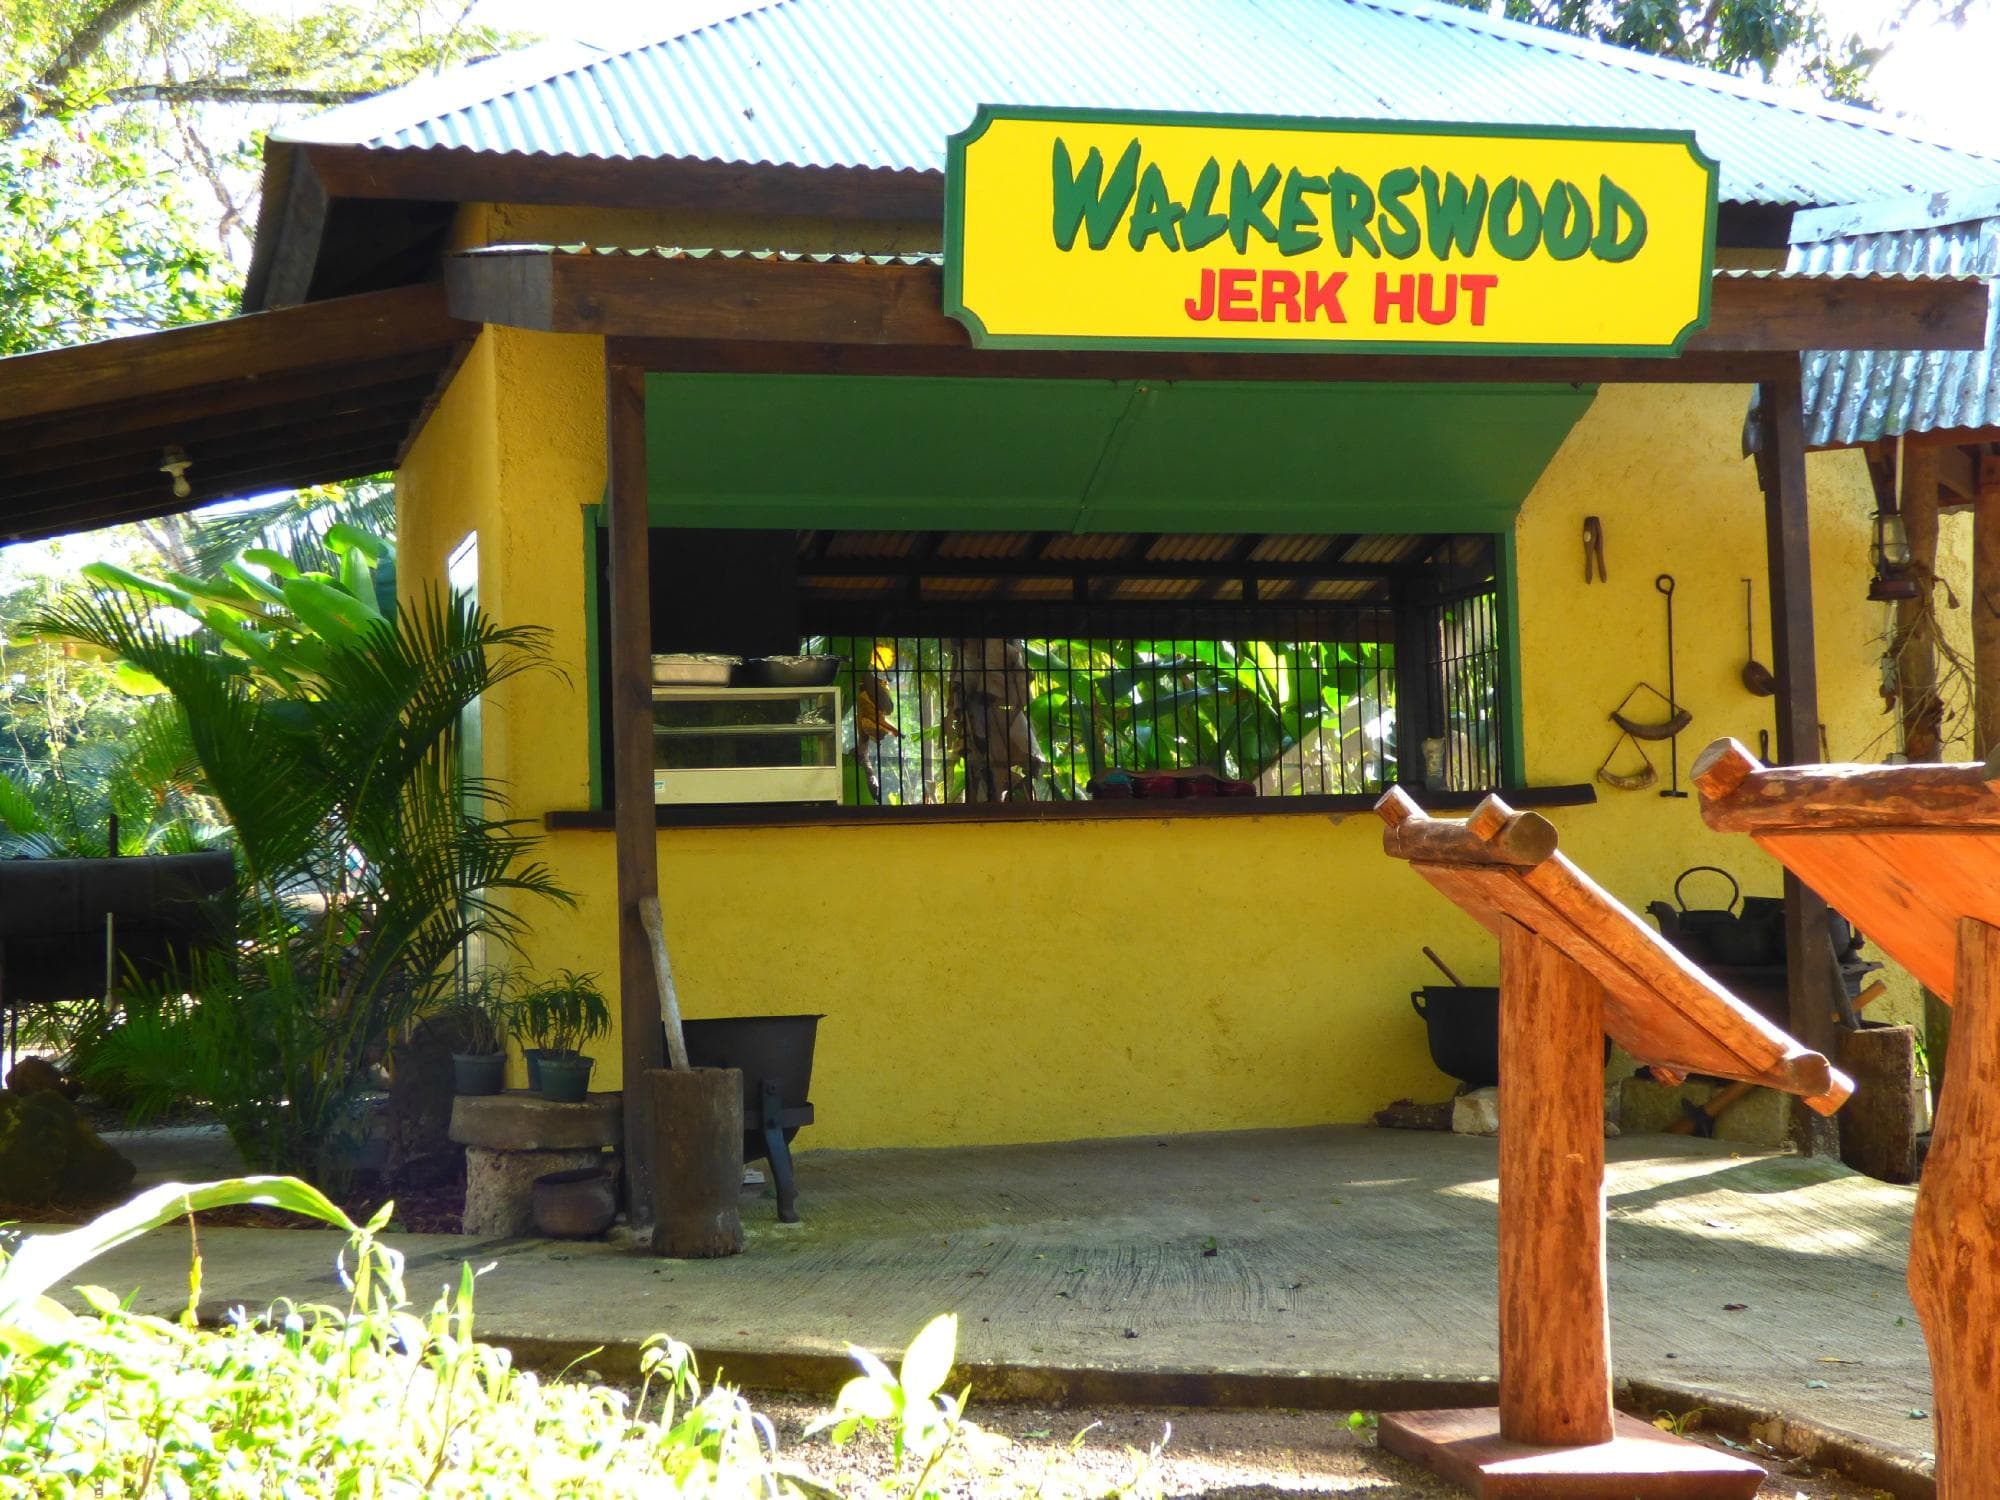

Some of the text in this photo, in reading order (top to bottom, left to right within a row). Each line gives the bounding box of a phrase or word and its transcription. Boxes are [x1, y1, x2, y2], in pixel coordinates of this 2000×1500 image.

[1053, 137, 1648, 263] WALKERSWOOD
[1185, 268, 1499, 326] JERK HUT
